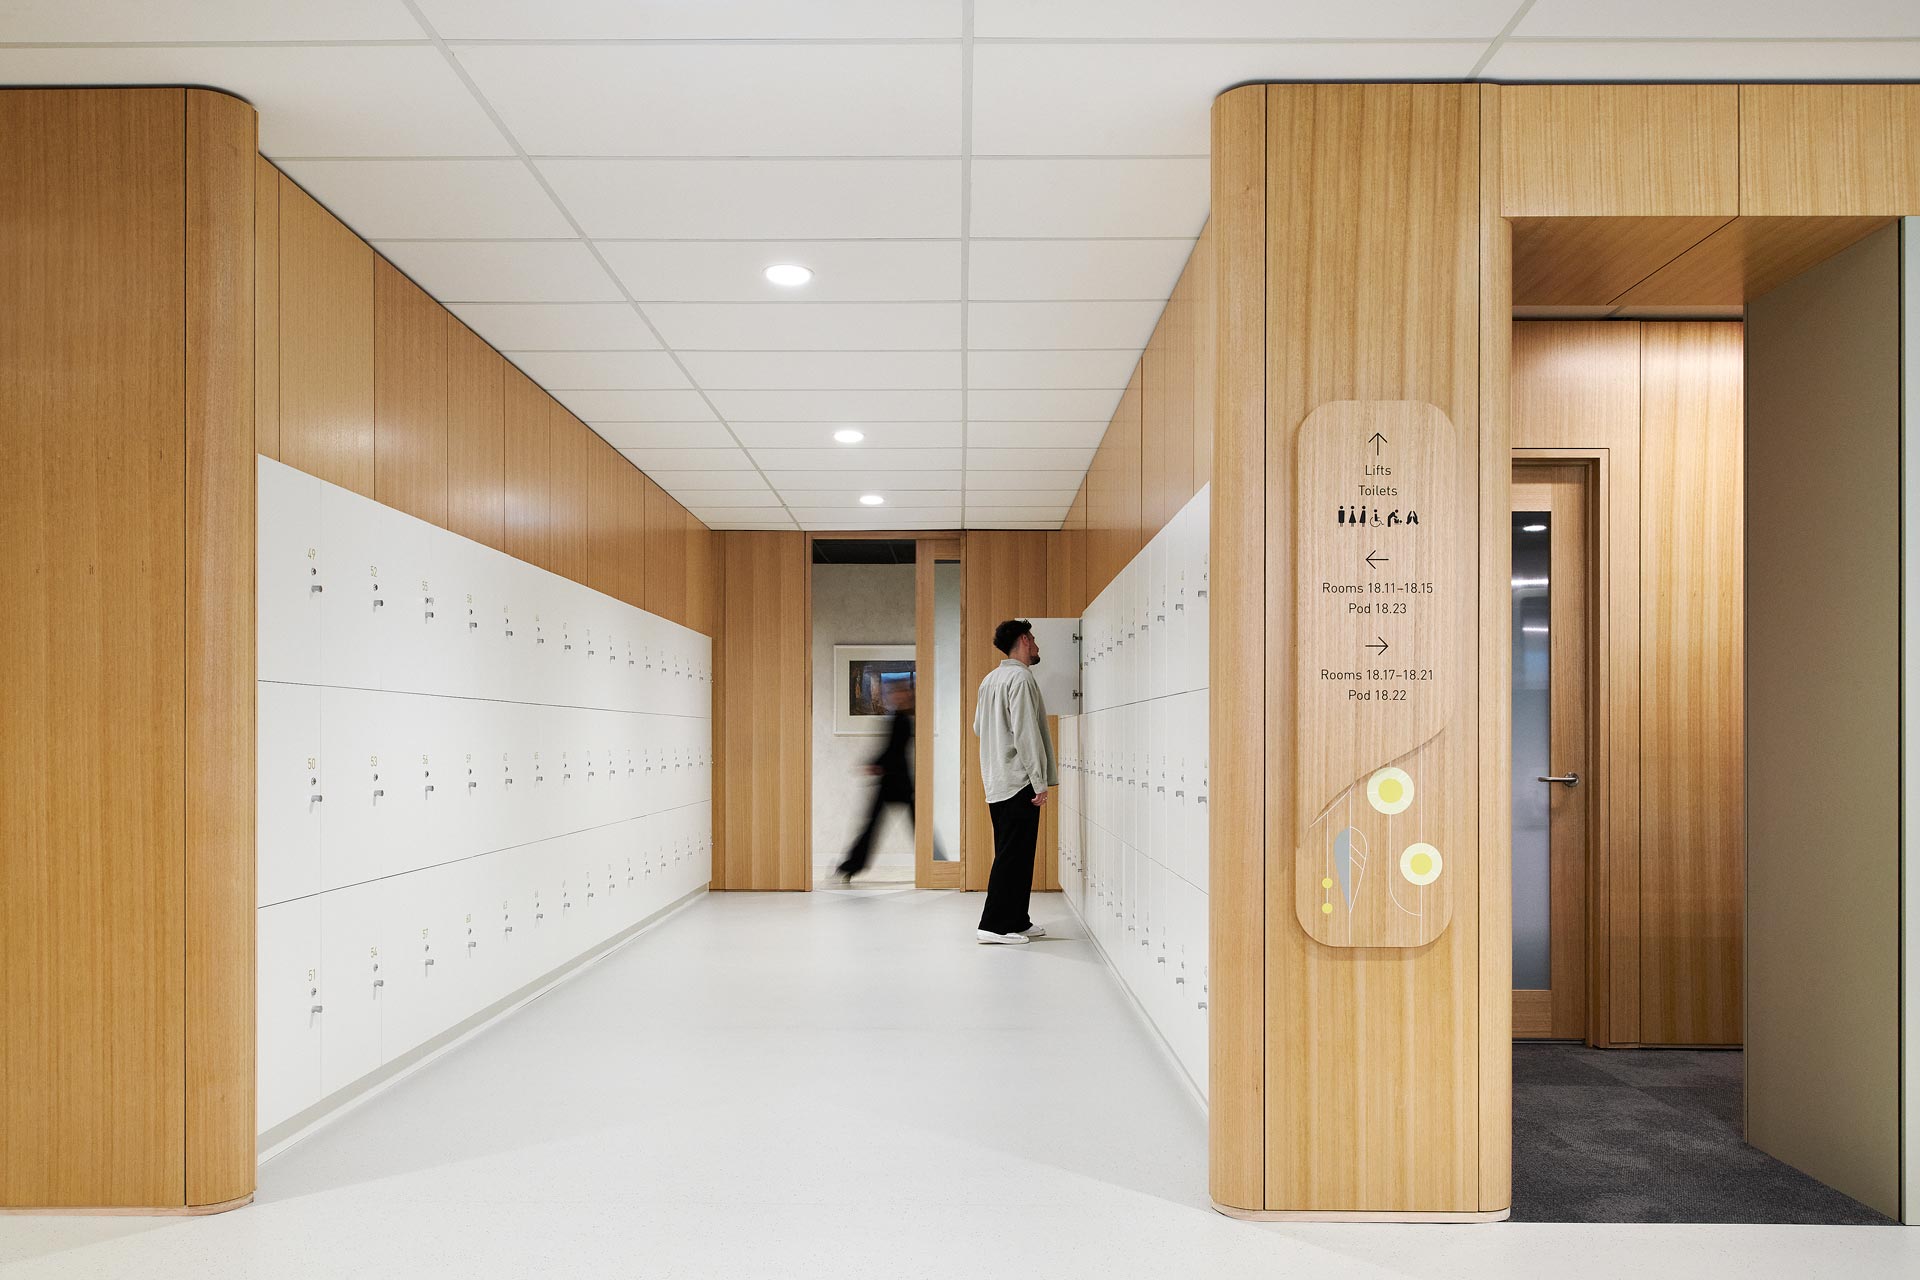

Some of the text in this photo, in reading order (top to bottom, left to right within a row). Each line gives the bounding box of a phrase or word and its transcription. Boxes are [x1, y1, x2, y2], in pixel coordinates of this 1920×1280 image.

[1365, 464, 1392, 476] Lifts
[1358, 484, 1398, 496] Toilets
[307, 547, 316, 560] 49
[370, 565, 378, 578] 52
[1322, 582, 1364, 594] Rooms
[1348, 602, 1407, 614] Pod 18.23
[1321, 669, 1363, 681] Rooms
[1348, 689, 1407, 701] Pod 18.22
[307, 757, 316, 770] 50
[370, 755, 378, 768] 53
[370, 946, 378, 959] 54
[308, 968, 316, 982] 51
